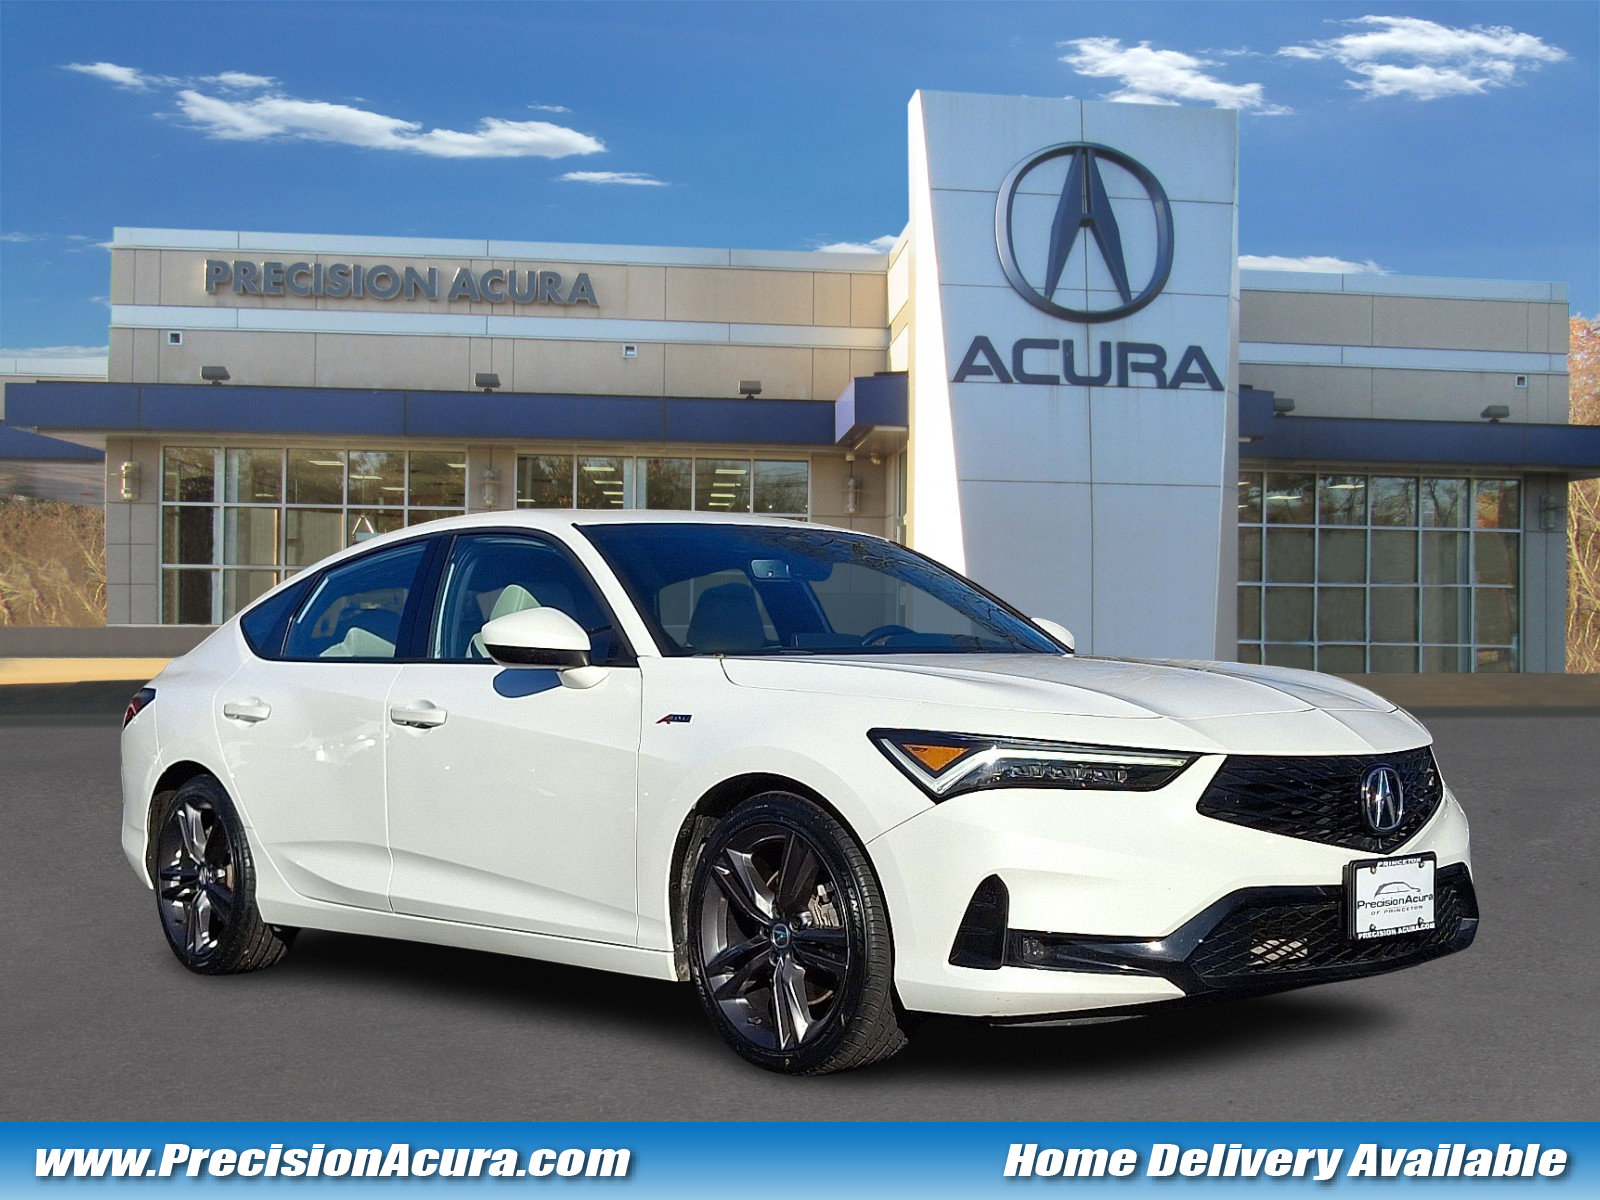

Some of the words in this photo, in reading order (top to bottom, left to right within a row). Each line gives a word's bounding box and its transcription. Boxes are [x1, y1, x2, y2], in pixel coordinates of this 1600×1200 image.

[204, 258, 439, 301] PRECISION
[447, 267, 599, 306] ACURA
[952, 335, 1225, 392] ACURA
[1377, 857, 1421, 867] PRINCETON
[1357, 894, 1434, 910] PrecisionAcura
[1383, 905, 1424, 914] PRINCETON
[1358, 928, 1397, 940] PRECISION
